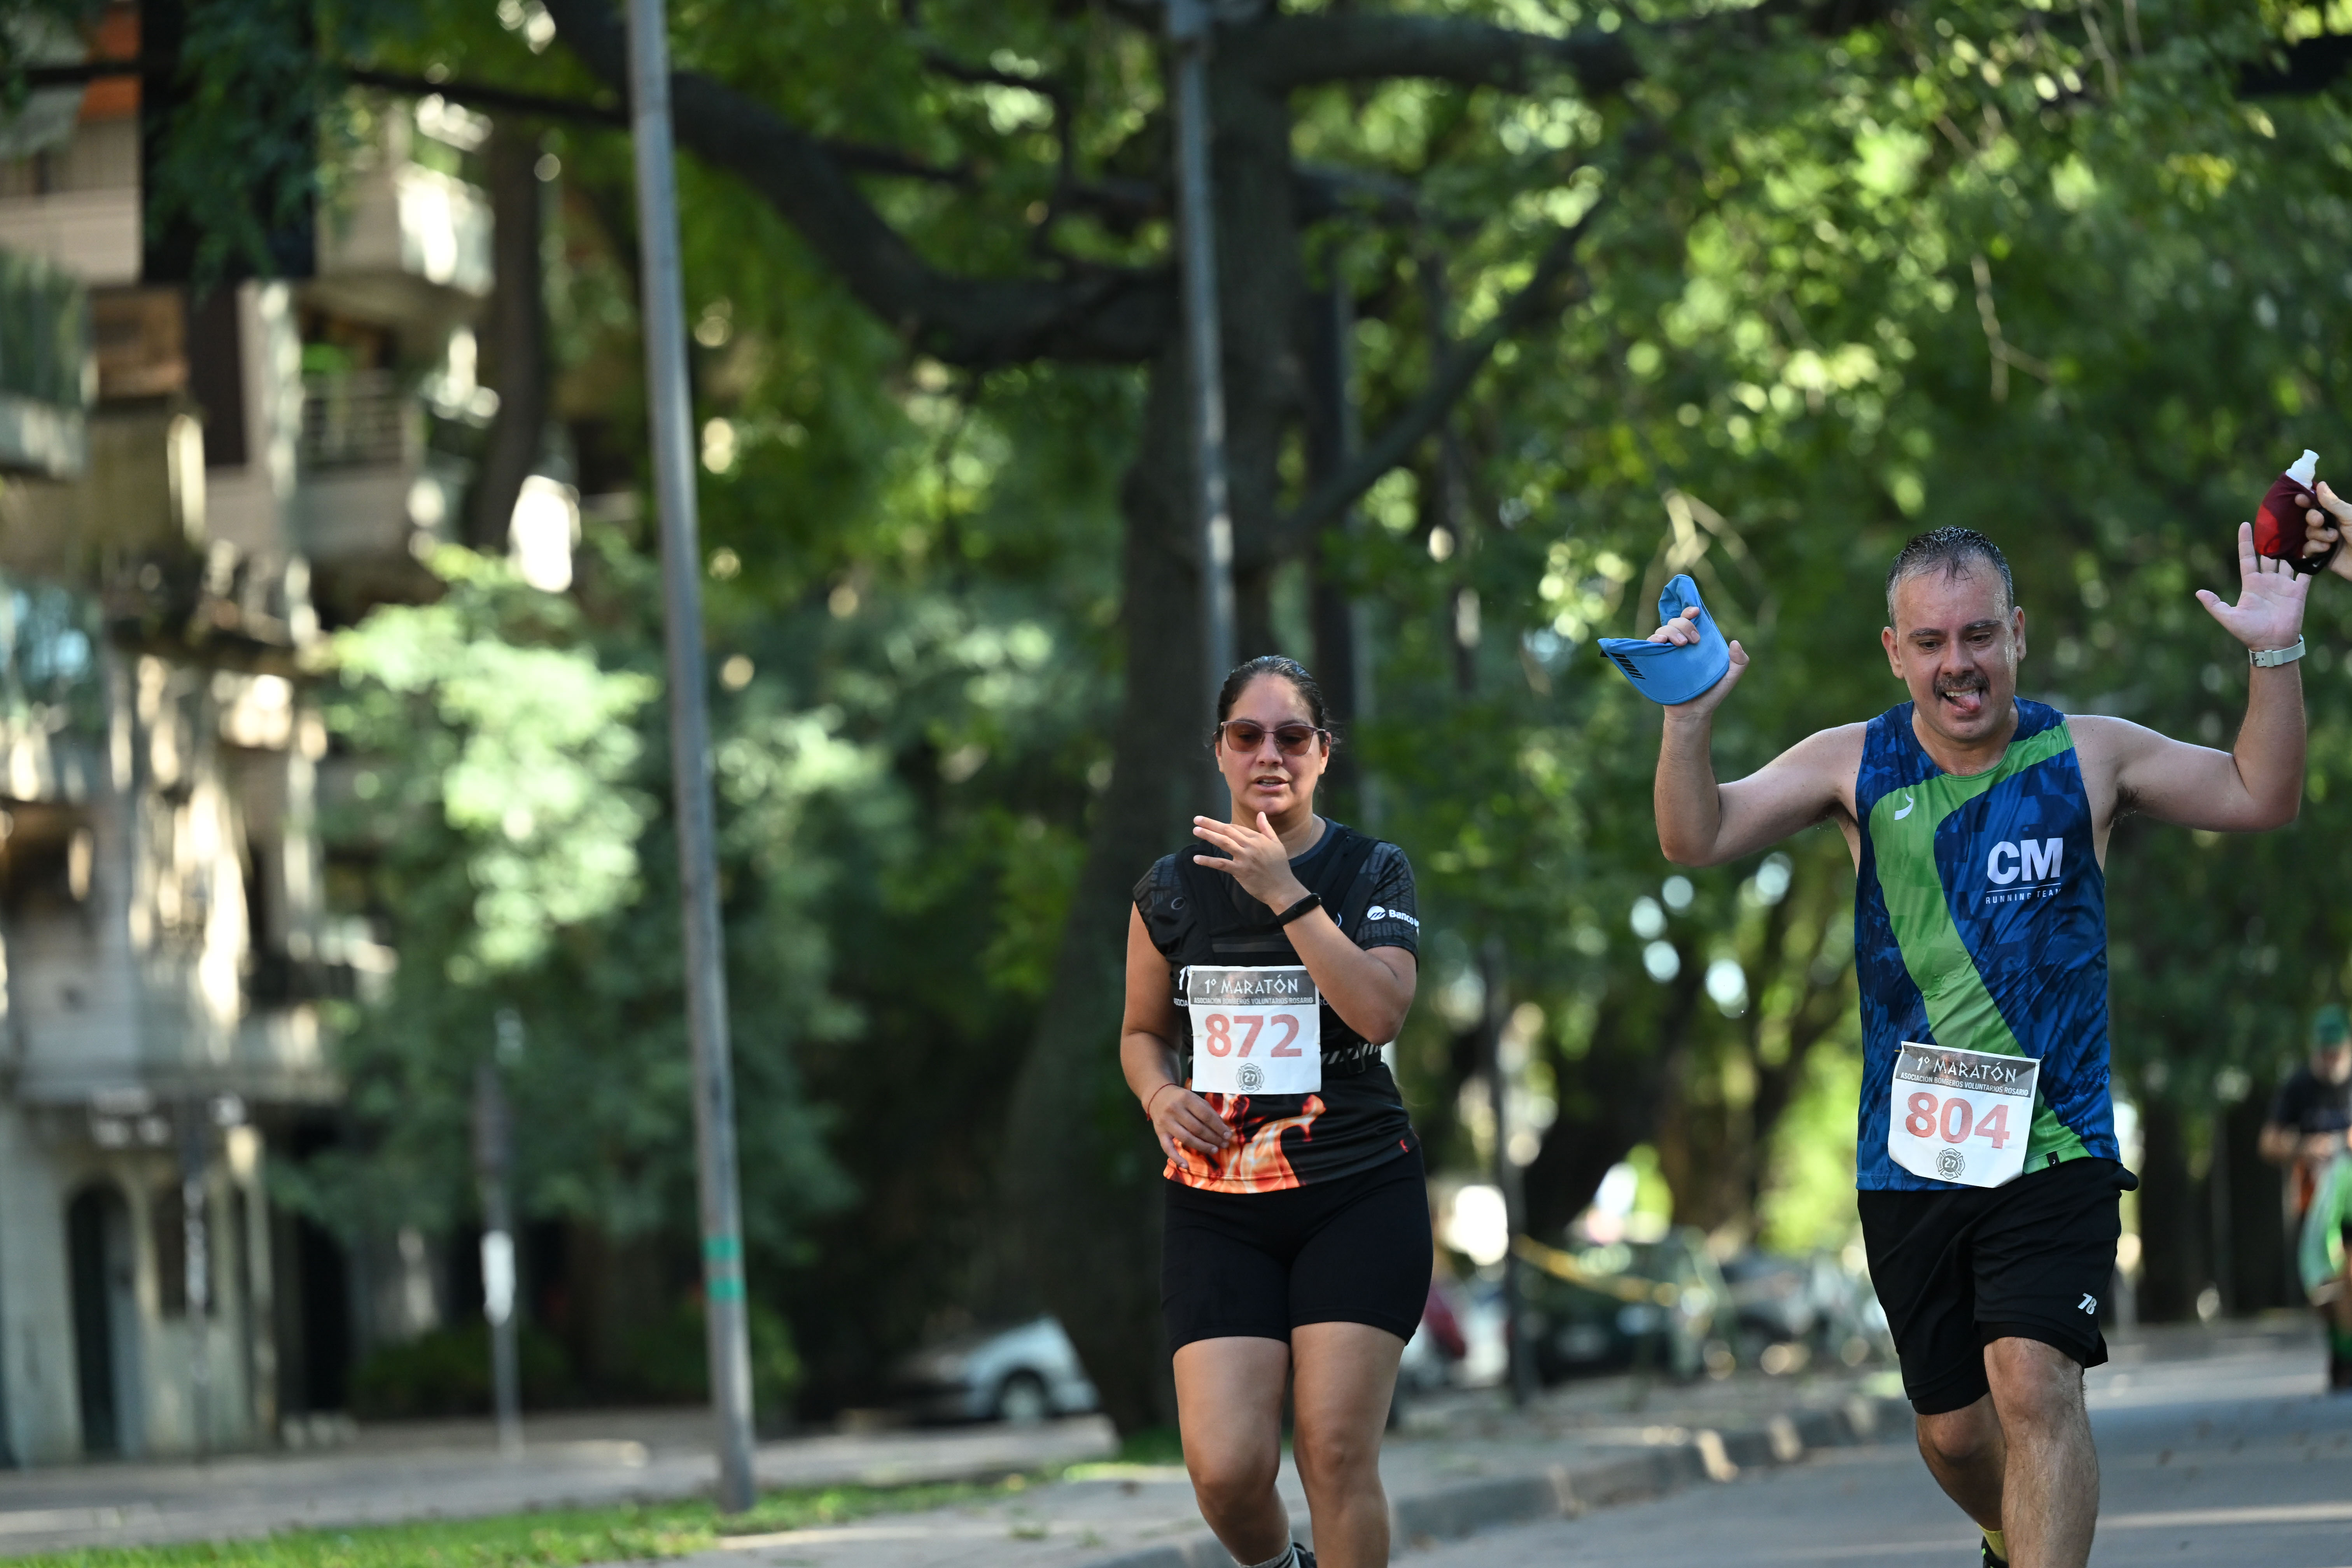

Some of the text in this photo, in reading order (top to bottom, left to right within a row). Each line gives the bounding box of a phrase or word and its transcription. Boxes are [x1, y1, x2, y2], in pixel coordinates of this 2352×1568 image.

[1987, 838, 2063, 884] CM
[1986, 892, 2032, 904] RUNNING
[1389, 909, 1414, 925] Banco
[1221, 974, 1298, 994] MARATÓN
[1205, 1013, 1302, 1057] 872
[1244, 1072, 1256, 1083] 27
[1933, 1058, 2017, 1083] MARATÓN
[1900, 1072, 2028, 1096] ASOCIACIÓN BOMBEROS VOLUNTARIOS ROSARIO
[1906, 1092, 2010, 1149] 804
[1944, 1157, 1956, 1168] 27
[2077, 1292, 2097, 1314] 78
